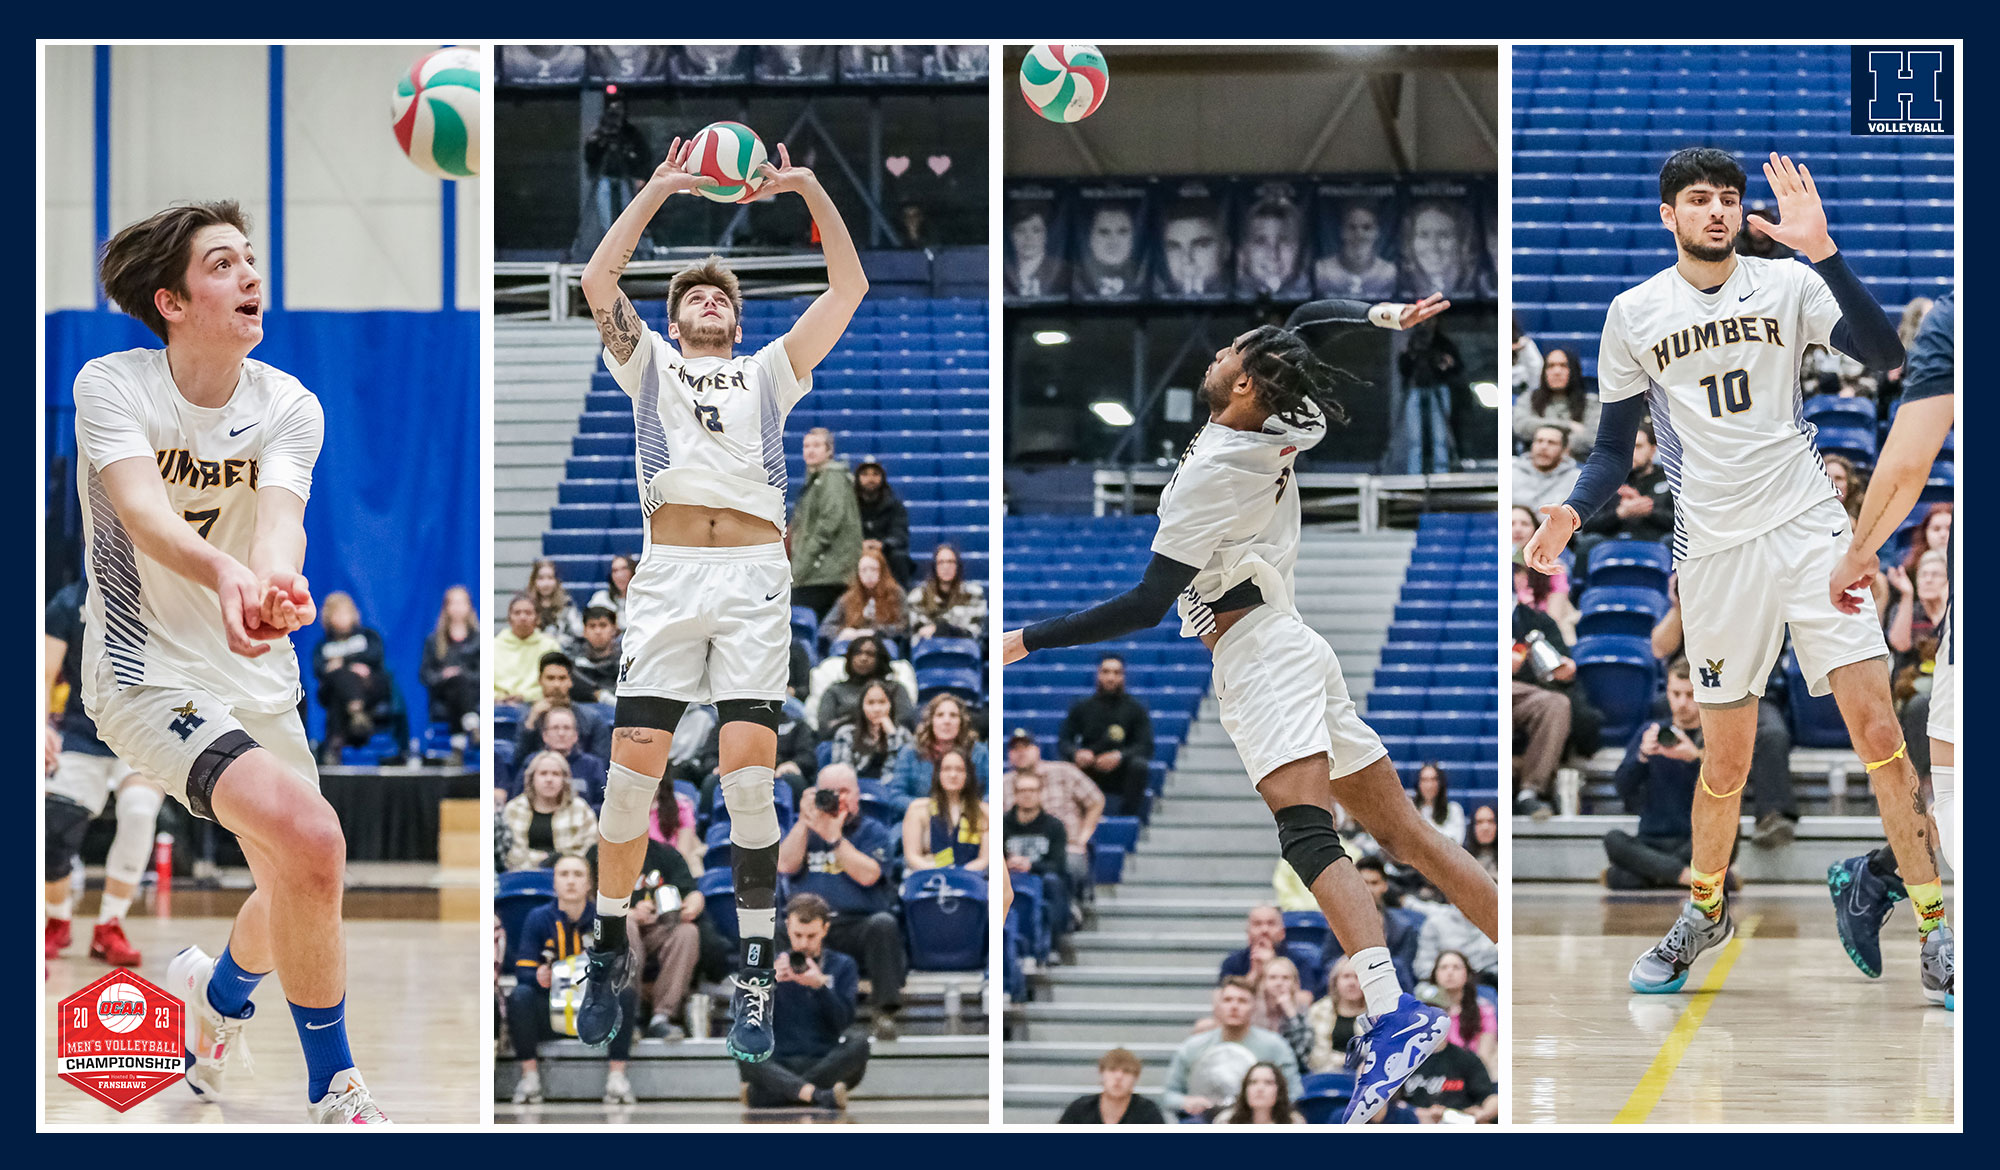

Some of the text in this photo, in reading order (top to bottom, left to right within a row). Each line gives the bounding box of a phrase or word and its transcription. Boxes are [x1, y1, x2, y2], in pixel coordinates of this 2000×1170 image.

[1651, 316, 1786, 373] HUMBER
[1699, 368, 1753, 418] 10
[156, 448, 260, 493] UMBE
[1698, 666, 1721, 688] H
[167, 711, 207, 743] H
